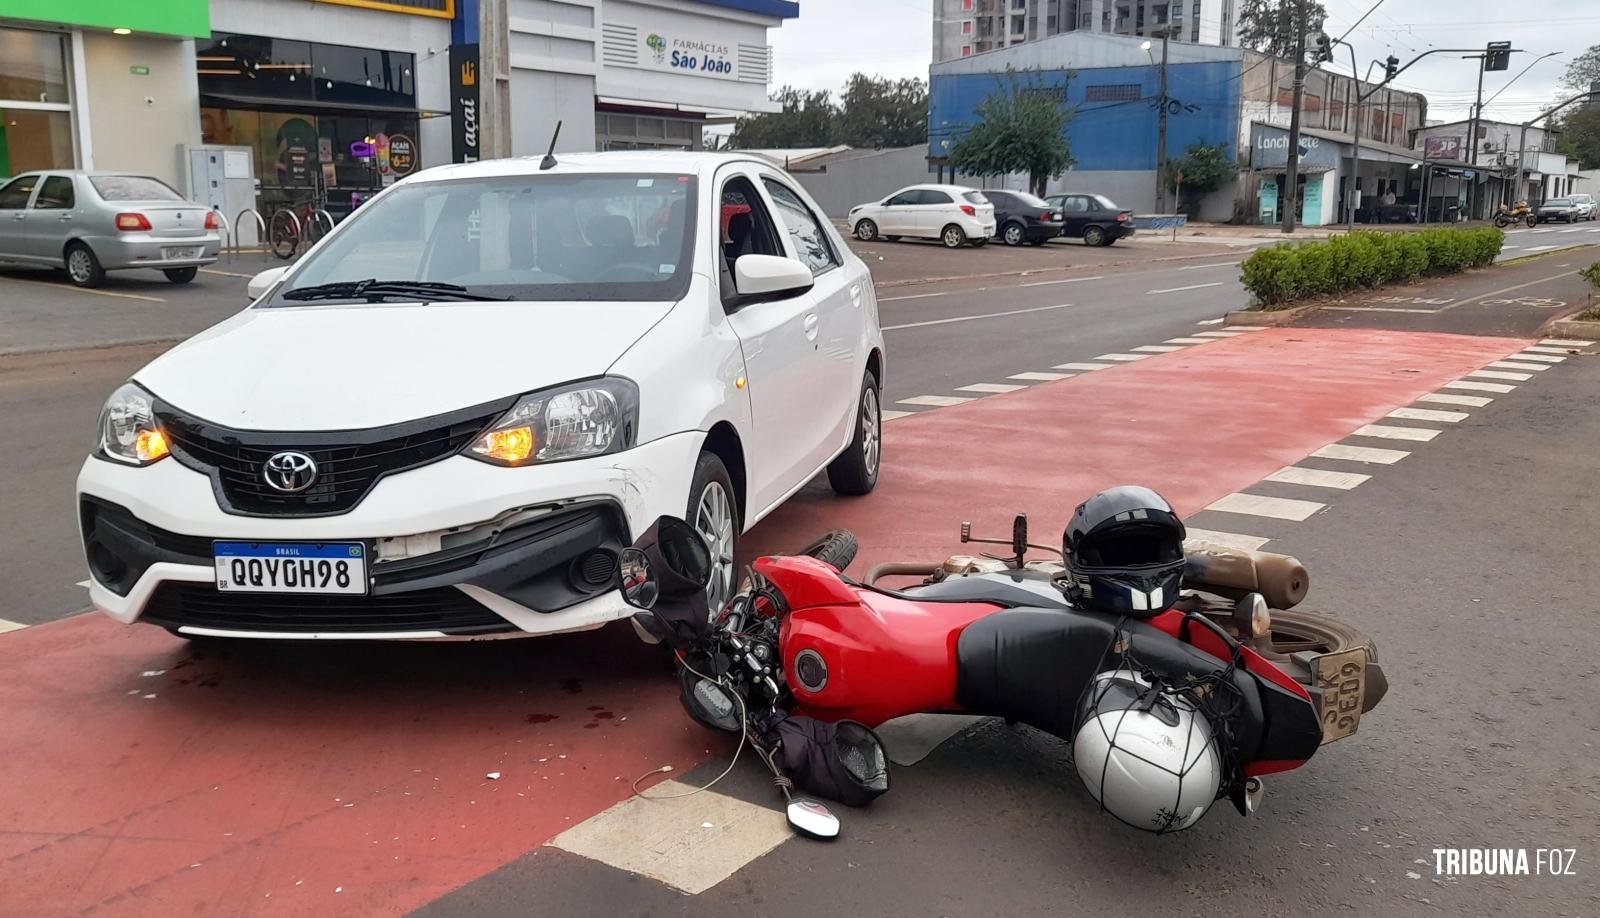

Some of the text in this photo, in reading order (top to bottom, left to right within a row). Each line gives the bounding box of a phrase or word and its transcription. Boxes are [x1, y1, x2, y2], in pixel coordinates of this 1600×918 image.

[674, 40, 728, 54] FARMÁCIAS
[671, 50, 732, 74] São João
[460, 98, 479, 147] açaí
[1257, 135, 1320, 149] Lanchete
[1440, 141, 1456, 150] JP
[275, 547, 300, 556] BRASIL
[231, 558, 350, 588] QQY0H98
